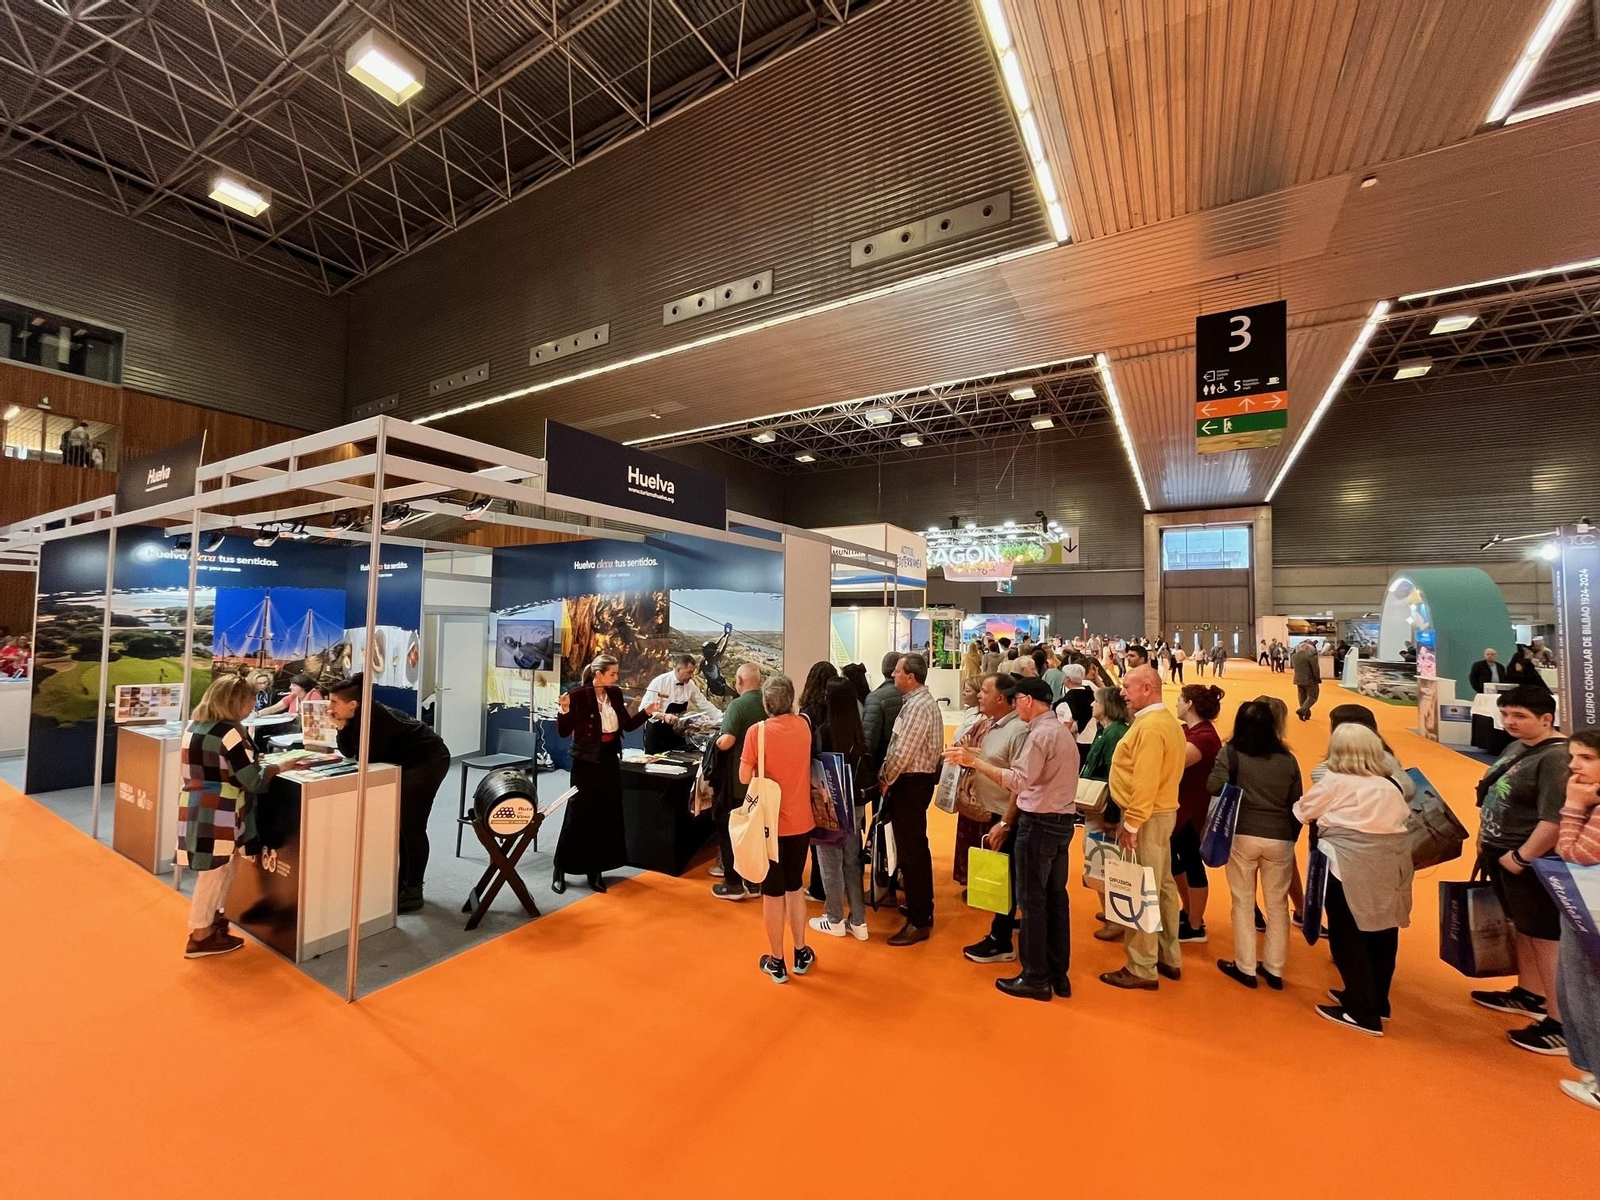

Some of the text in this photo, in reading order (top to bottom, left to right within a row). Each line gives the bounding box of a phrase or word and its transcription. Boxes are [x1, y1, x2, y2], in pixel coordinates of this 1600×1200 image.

[1229, 315, 1251, 352] 3
[1234, 380, 1241, 391] 5
[147, 465, 171, 484] Huelva
[628, 465, 674, 495] Huelva
[190, 553, 216, 562] leva
[218, 554, 235, 564] tus
[236, 556, 279, 567] sentidos.
[574, 561, 596, 570] Huelva
[614, 559, 626, 568] tus
[627, 557, 659, 567] sentidos.
[1579, 568, 1596, 725] CUERPO CONSULAR DE BILBAO 1924-2024
